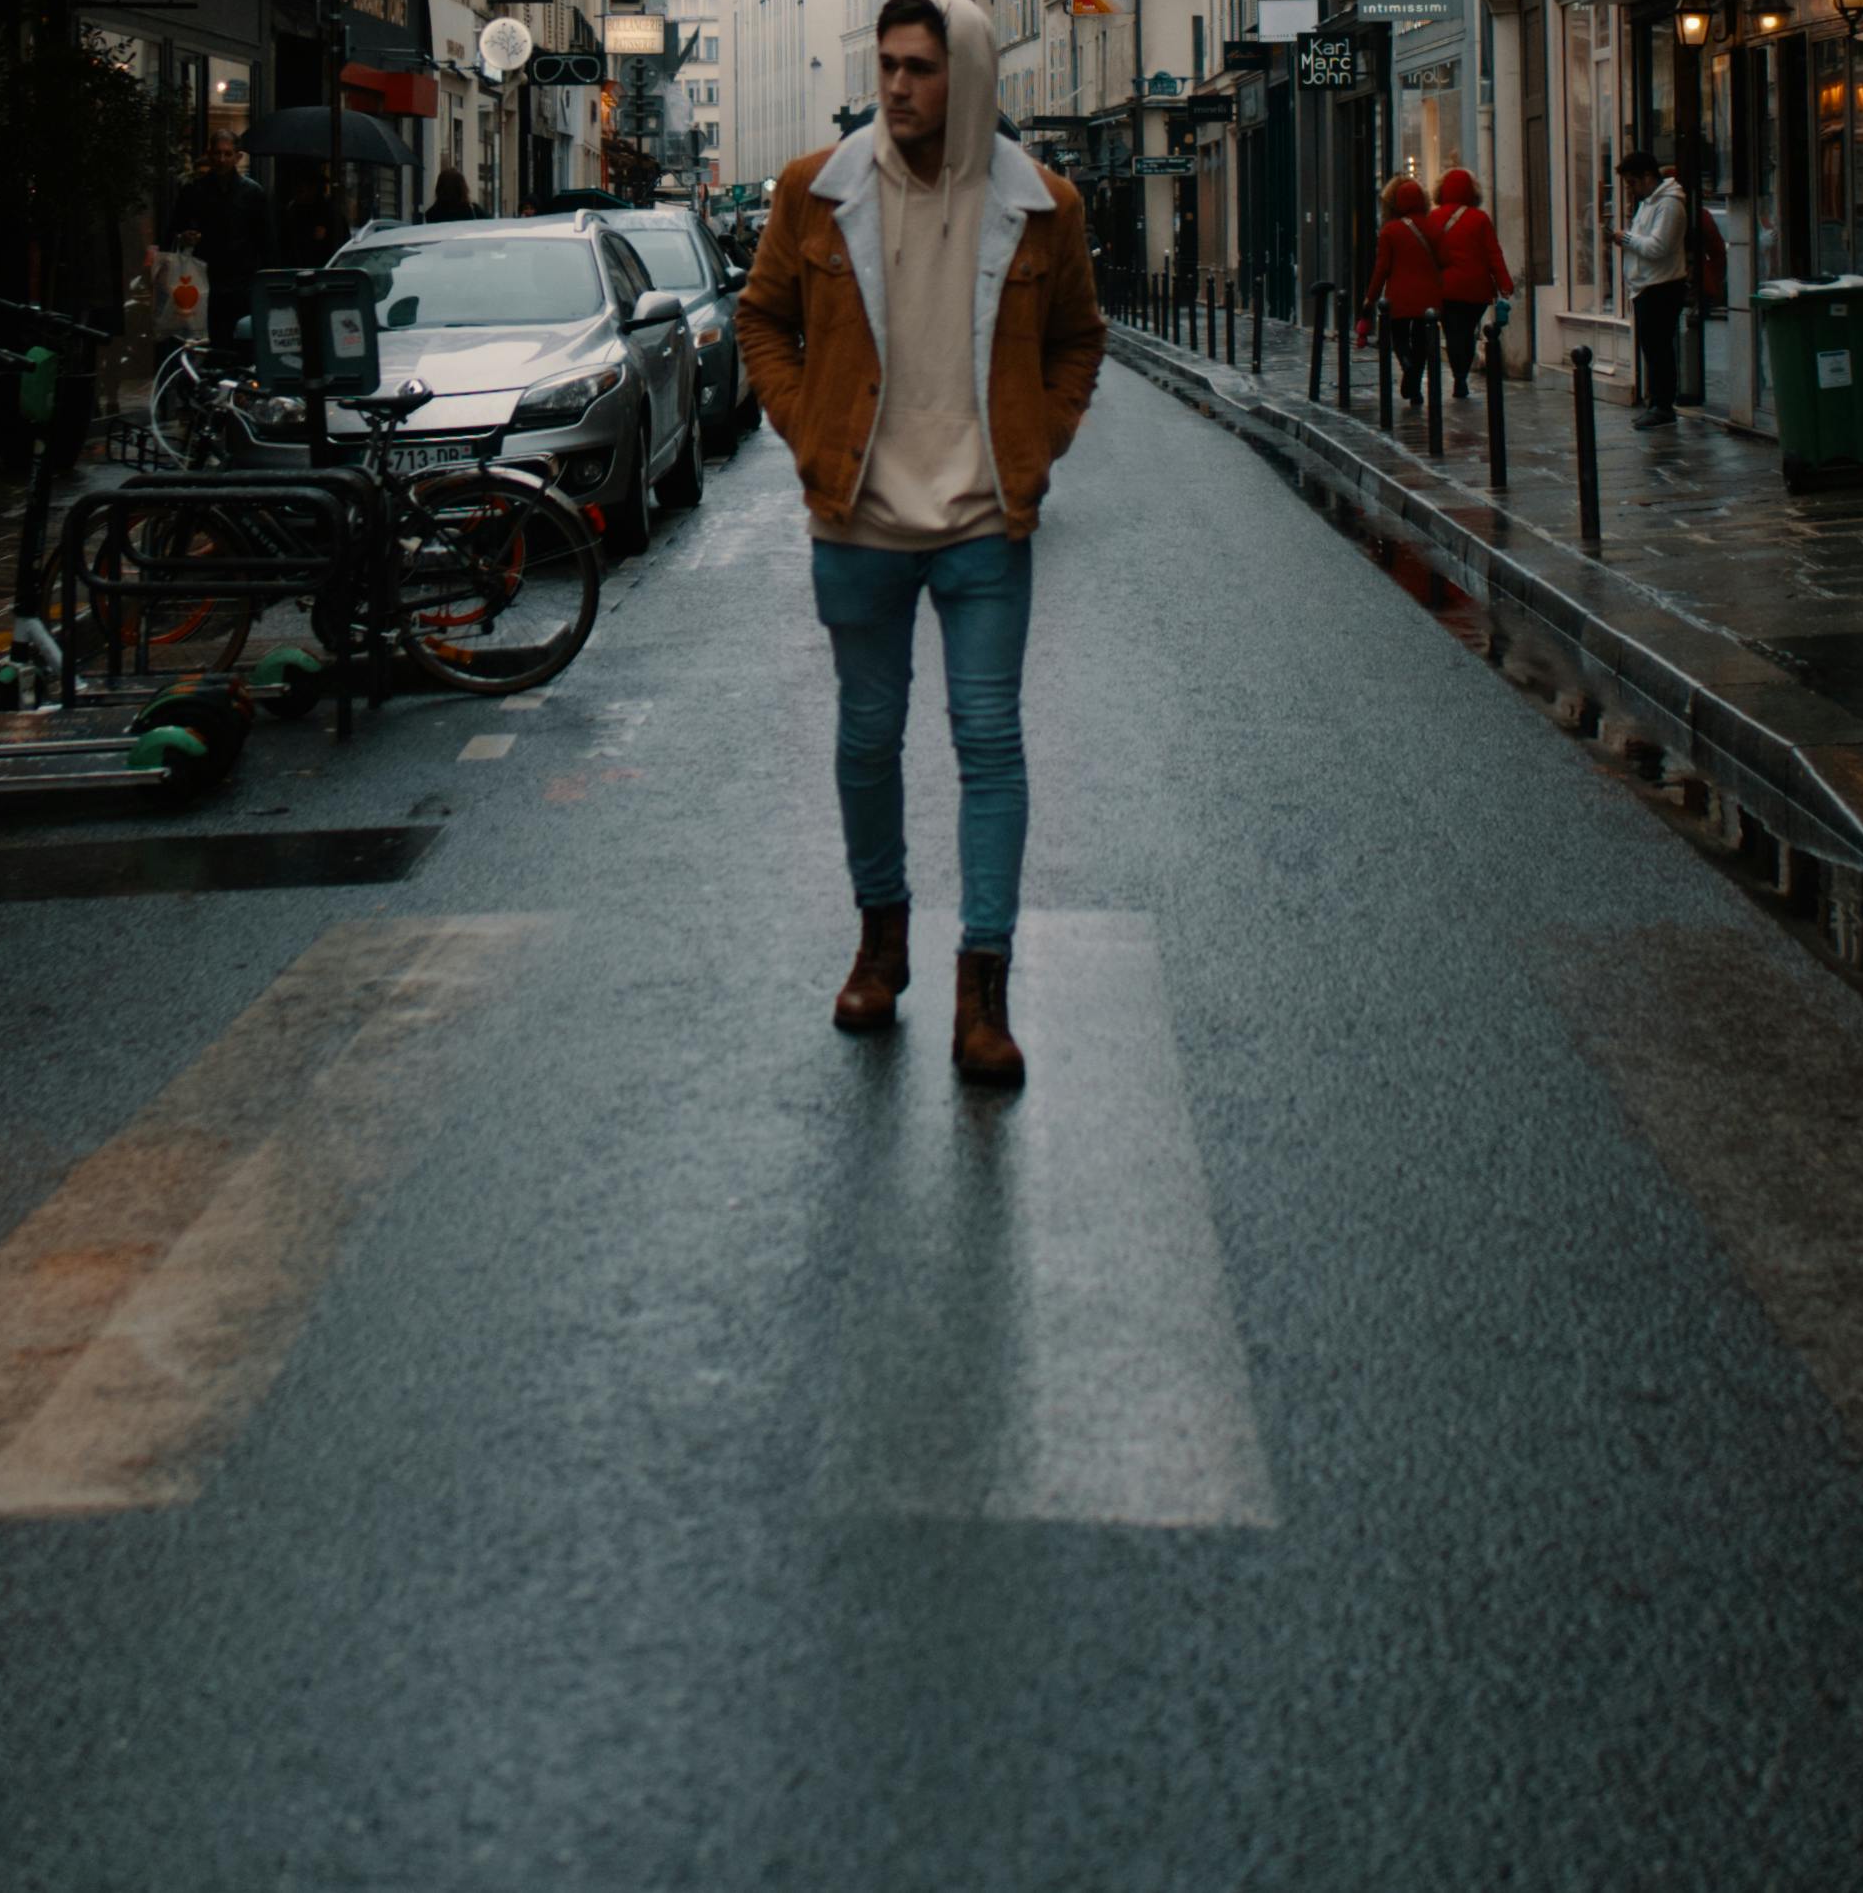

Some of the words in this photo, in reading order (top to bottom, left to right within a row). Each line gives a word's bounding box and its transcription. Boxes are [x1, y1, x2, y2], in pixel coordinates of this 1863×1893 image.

[1363, 2, 1448, 14] intimissimi
[1309, 37, 1352, 56] Karl
[1300, 52, 1352, 70] Marc
[1302, 67, 1352, 85] John
